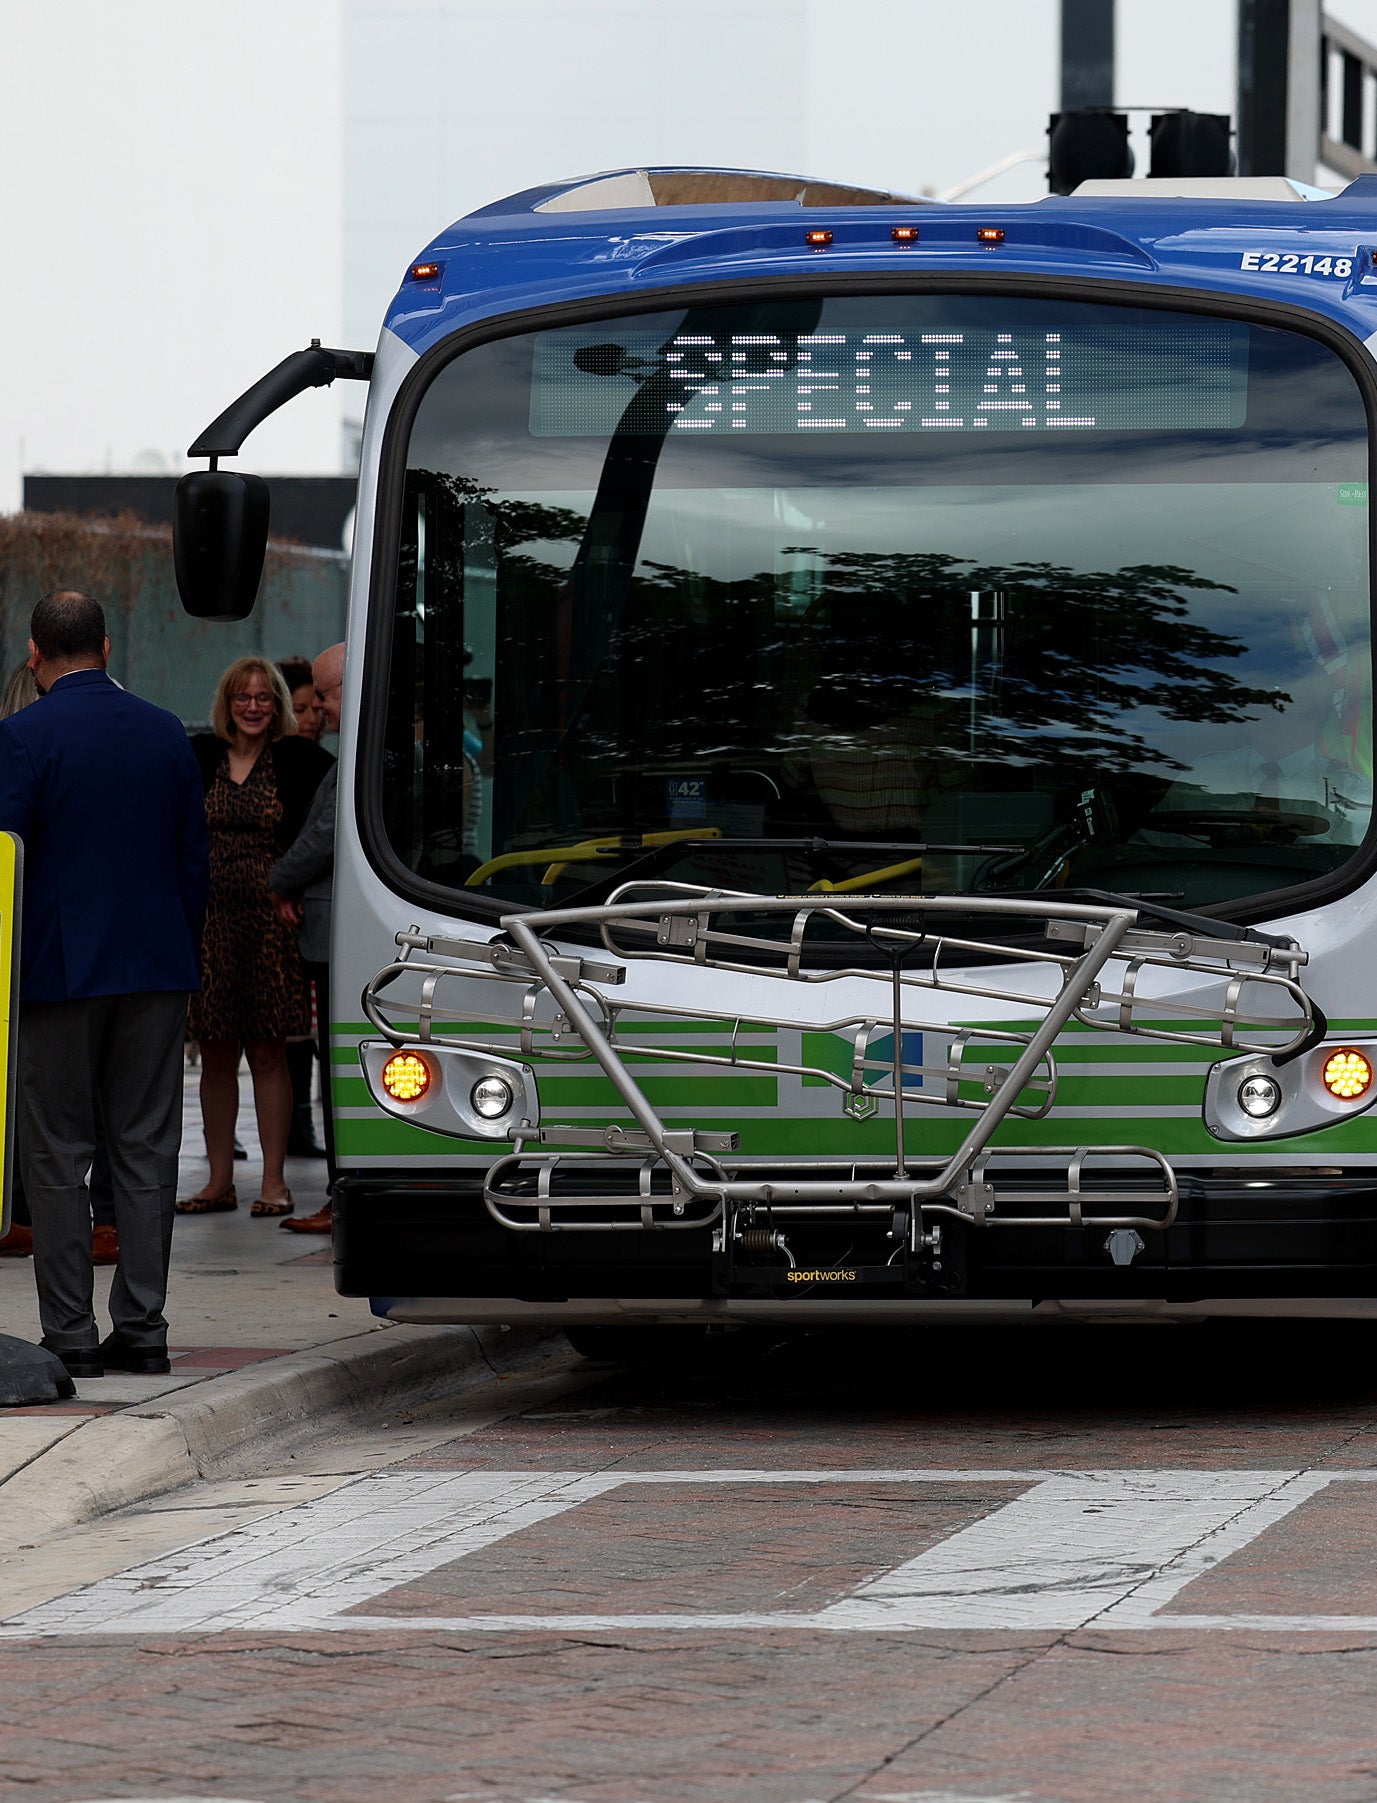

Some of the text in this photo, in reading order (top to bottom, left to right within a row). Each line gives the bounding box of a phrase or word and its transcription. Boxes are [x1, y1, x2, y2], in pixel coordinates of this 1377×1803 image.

[1240, 252, 1353, 278] E22148
[666, 333, 1096, 428] SPECIAL
[787, 1269, 856, 1283] sportworks
